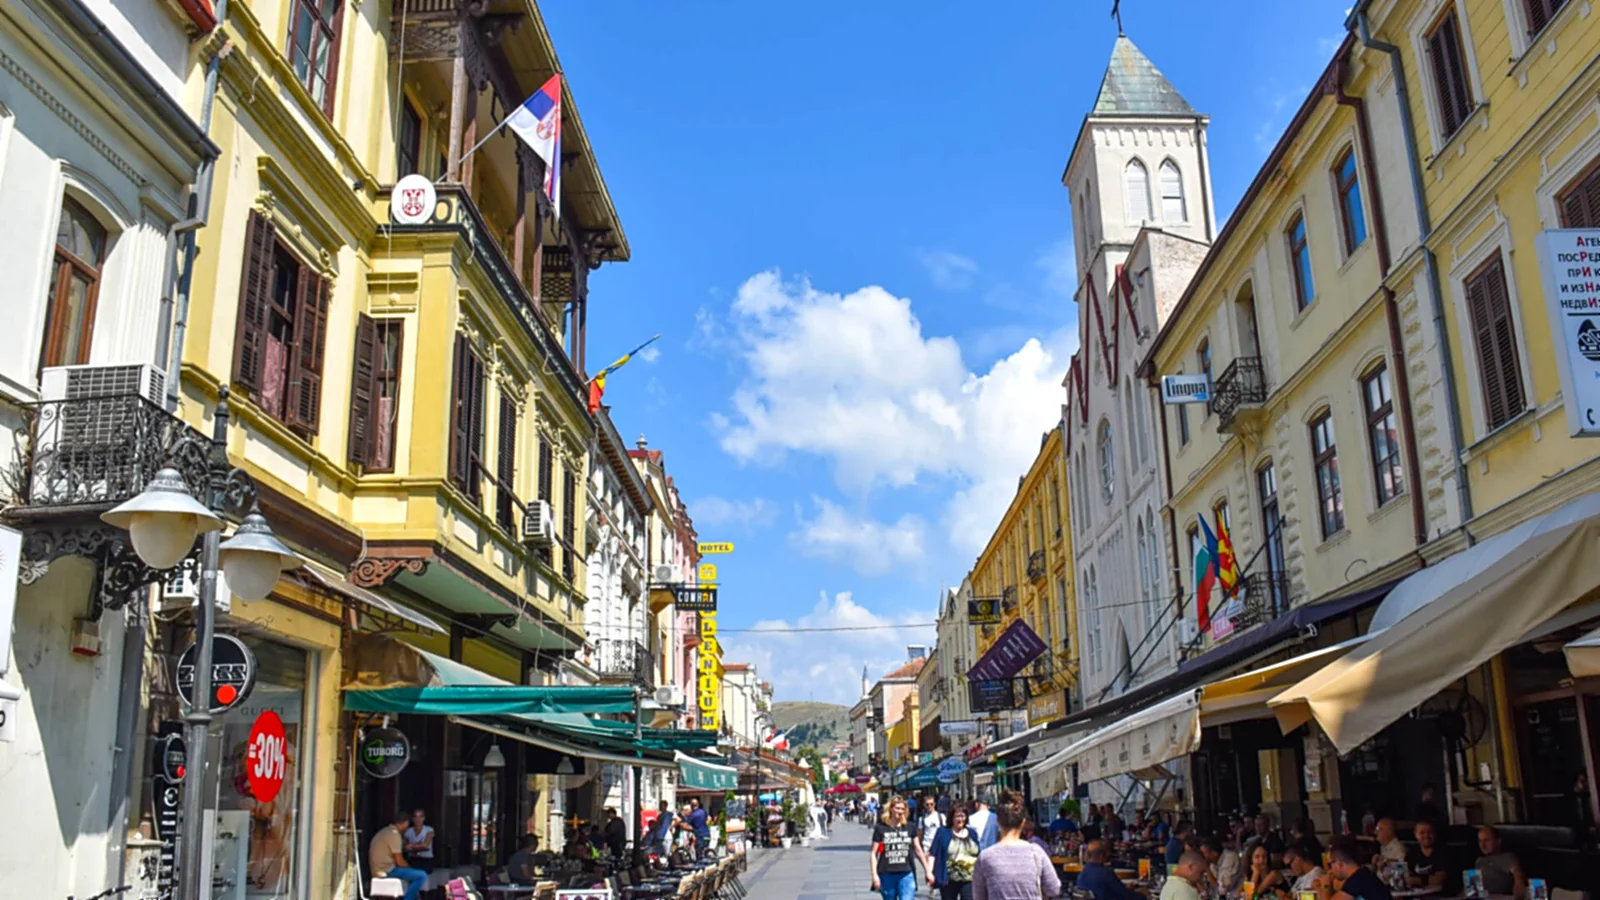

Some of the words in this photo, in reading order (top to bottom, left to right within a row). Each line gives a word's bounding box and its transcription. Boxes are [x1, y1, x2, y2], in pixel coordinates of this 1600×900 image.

[700, 544, 730, 552] HOTEL
[703, 567, 714, 726] MLENIUM
[368, 746, 404, 757] TUBORG
